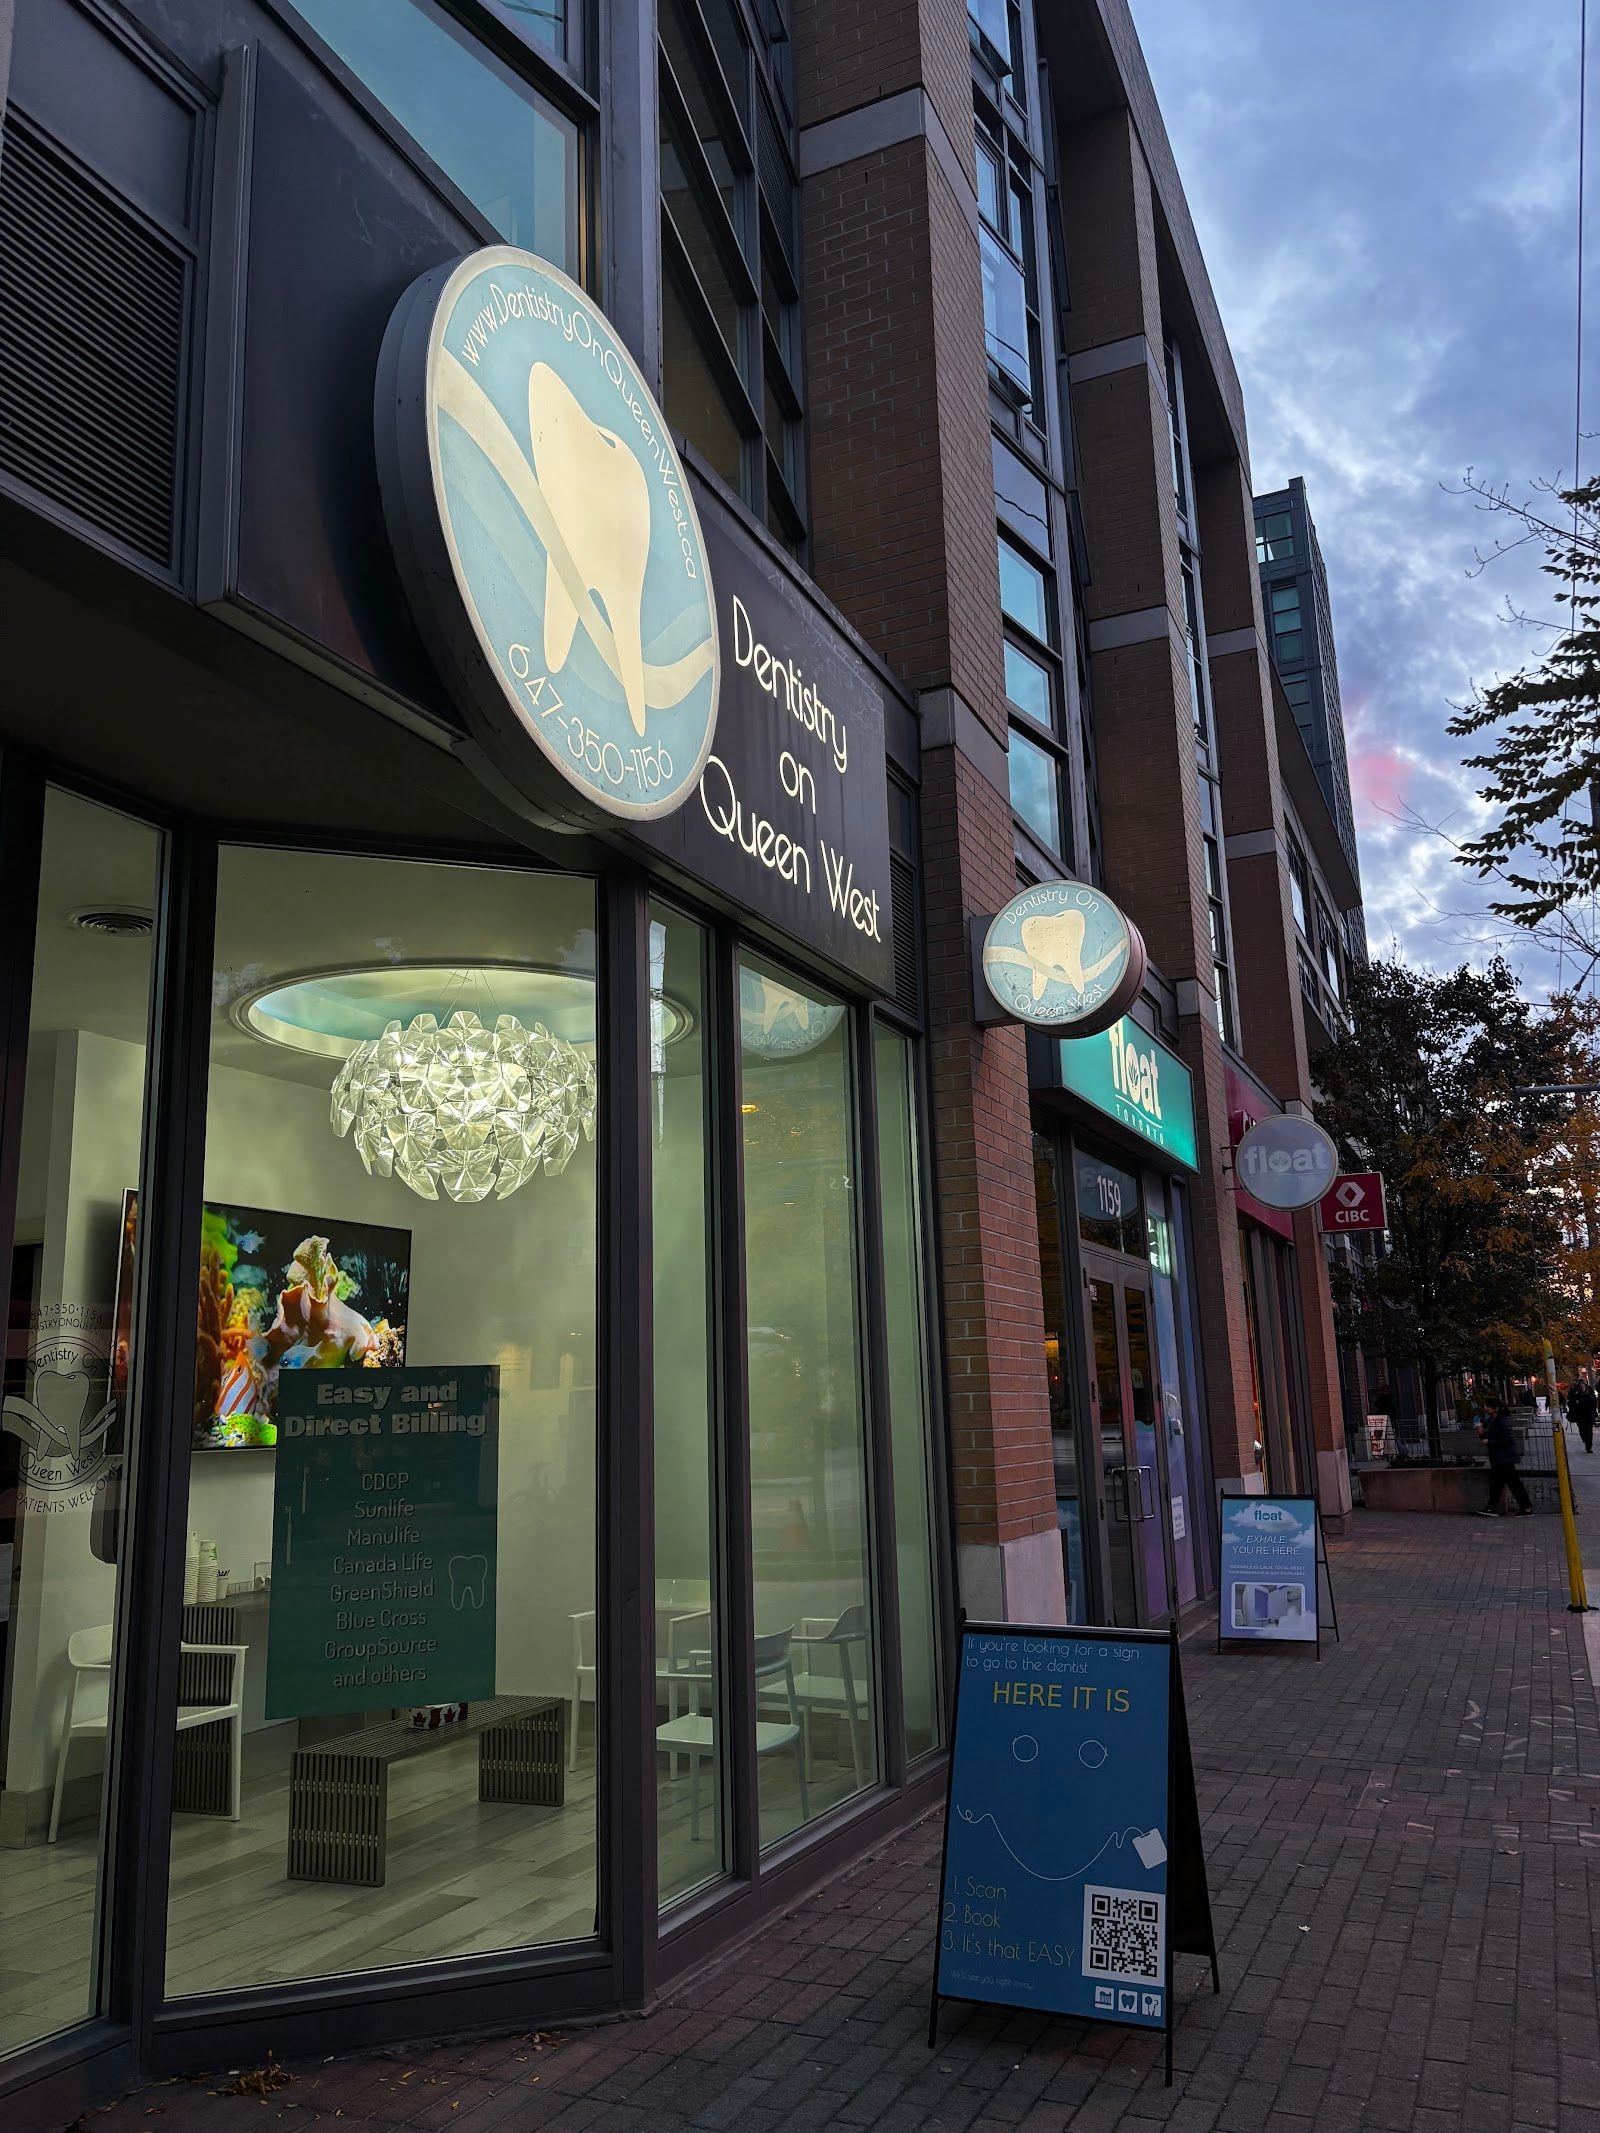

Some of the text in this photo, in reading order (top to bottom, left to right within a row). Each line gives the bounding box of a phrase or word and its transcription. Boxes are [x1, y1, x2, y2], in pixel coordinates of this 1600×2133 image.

[733, 594, 848, 774] Dentistry
[508, 643, 674, 789] 647-350-1156
[779, 751, 817, 815] on
[700, 755, 882, 944] Queen West
[1003, 889, 1100, 926] Dentistry On
[1014, 983, 1108, 1018] Queen West
[1108, 1018, 1162, 1121] float
[1115, 1103, 1165, 1145] TORONTO
[1244, 1142, 1329, 1175] float
[1096, 1175, 1122, 1218] 1159
[1335, 1209, 1371, 1224] CIBC
[25, 1347, 98, 1377] Dentistry On
[316, 1380, 458, 1411] Easy and
[284, 1411, 487, 1438] Direct Billing
[21, 1449, 99, 1481] Queen West
[16, 1463, 119, 1513] PATIENTS WELCOME
[361, 1472, 410, 1492] CDCP
[353, 1498, 416, 1519] Sunlife
[1254, 1510, 1283, 1521] float
[346, 1525, 422, 1547] Manulife
[333, 1551, 434, 1575] Canada Life
[329, 1578, 435, 1603] GreenShield
[336, 1608, 428, 1631] Blue Cross
[324, 1636, 438, 1662] GroupSource
[967, 1636, 1141, 1662] If you're looking for a sign
[332, 1663, 428, 1688] and others
[966, 1656, 1089, 1674] to go to the dentist
[992, 1681, 1132, 1713] HERE IT IS
[965, 1875, 1008, 1900] Scan
[942, 1901, 1001, 1929] 2. Book
[941, 1929, 1077, 1967] 3. It's that EASY
